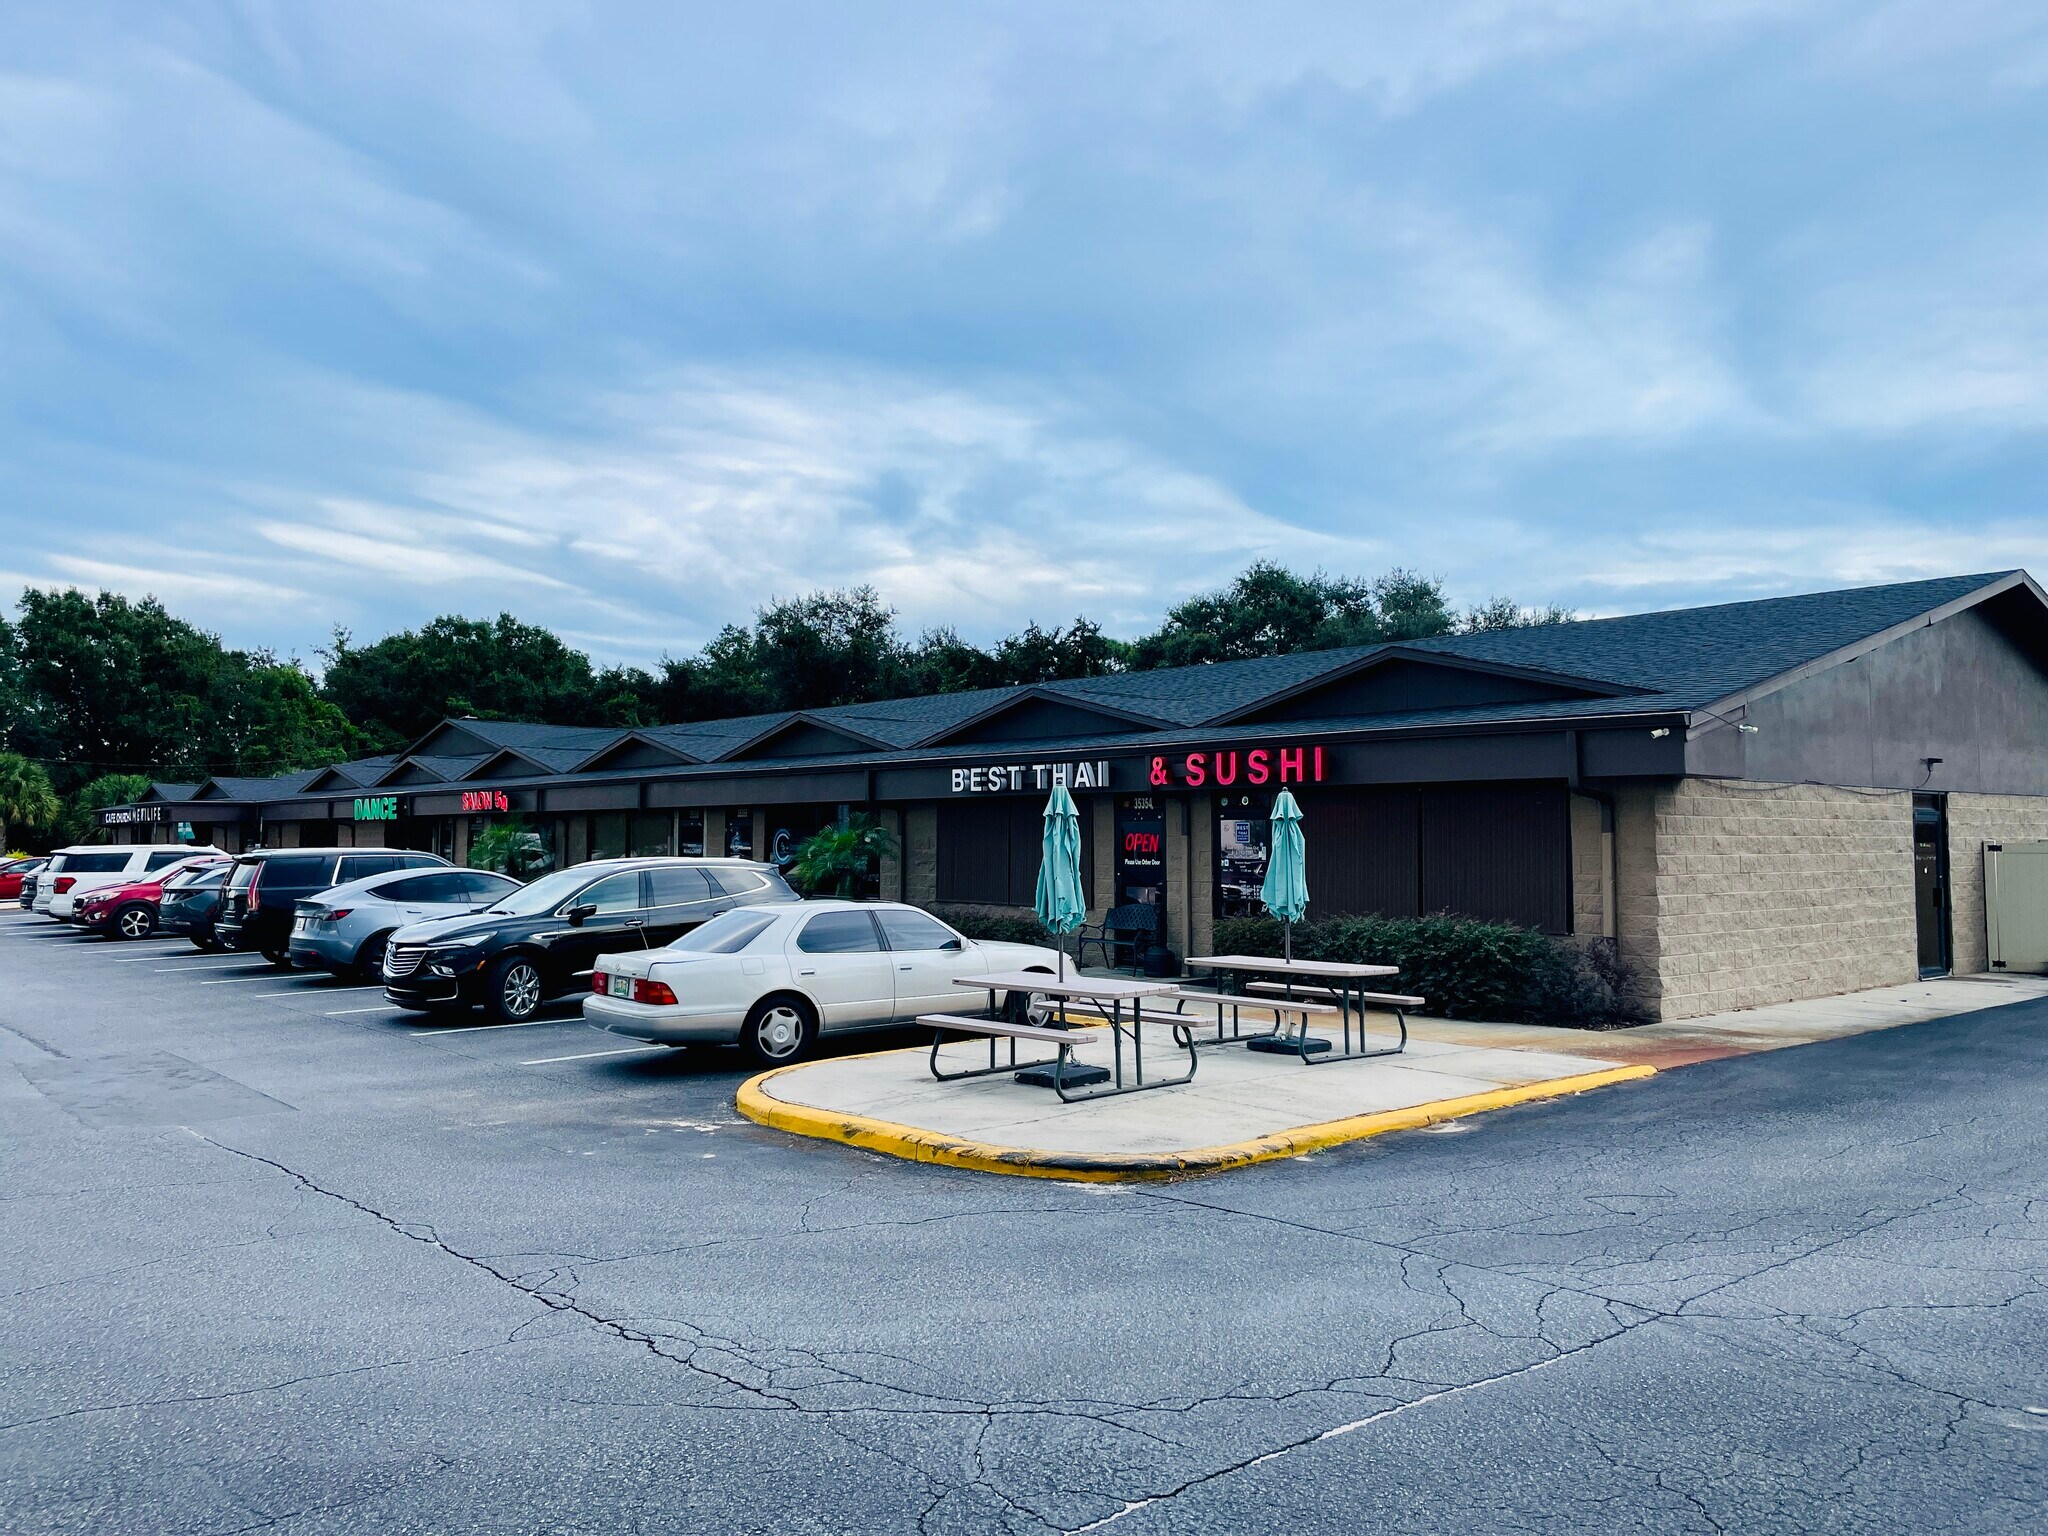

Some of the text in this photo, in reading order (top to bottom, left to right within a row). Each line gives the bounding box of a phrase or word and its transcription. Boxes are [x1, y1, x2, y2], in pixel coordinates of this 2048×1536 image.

[952, 746, 1324, 792] BEST THAI & SUSHI
[354, 797, 397, 820] DANCE
[462, 792, 492, 811] SALON
[1125, 833, 1160, 853] OPEN
